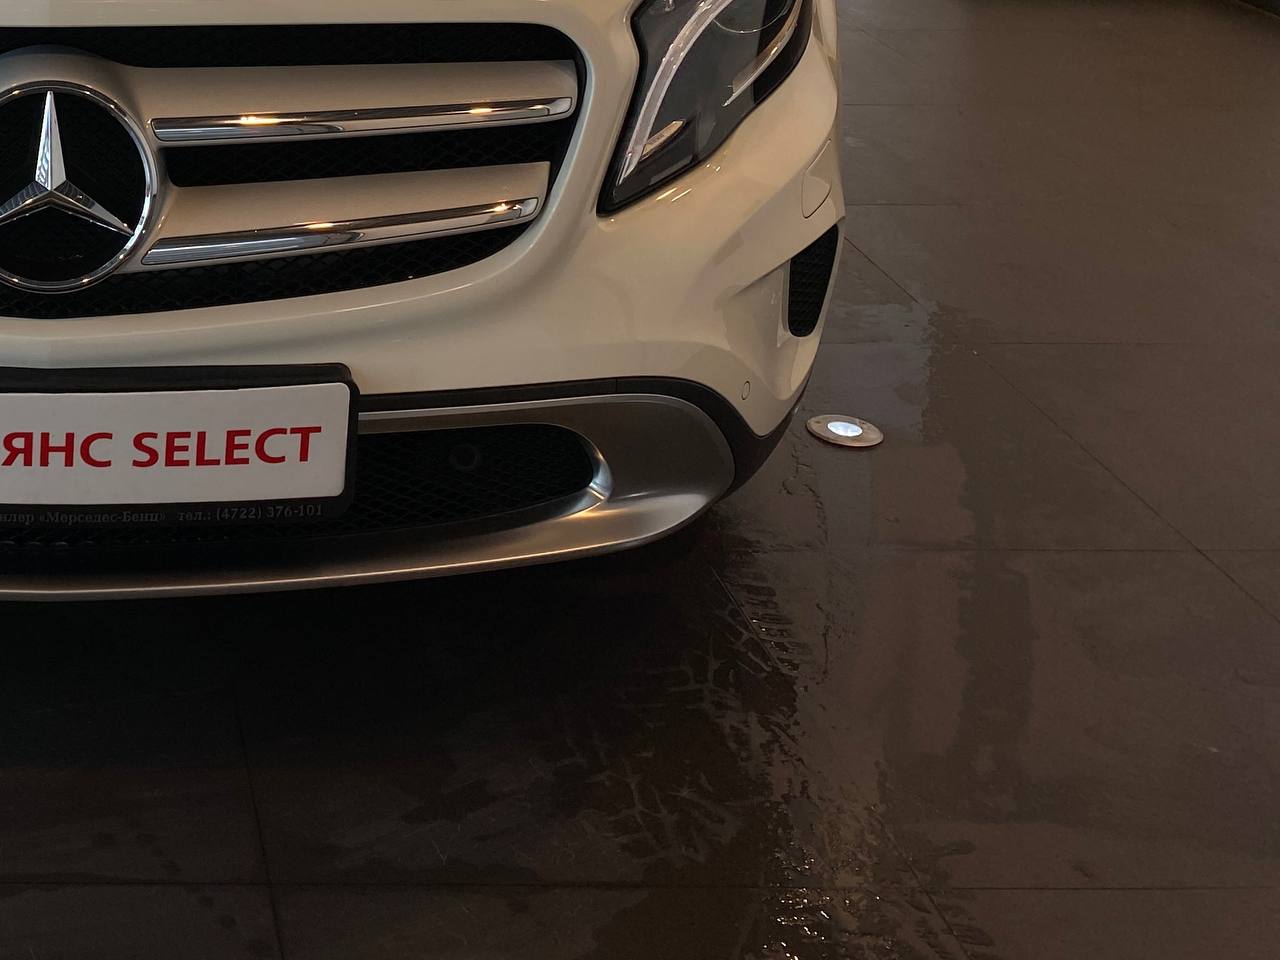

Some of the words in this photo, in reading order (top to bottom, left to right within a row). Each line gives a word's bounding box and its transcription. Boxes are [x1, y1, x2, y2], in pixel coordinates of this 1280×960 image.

[131, 426, 322, 468] SELECT
[216, 506, 262, 521] (4722)
[265, 503, 322, 517] 376-101
